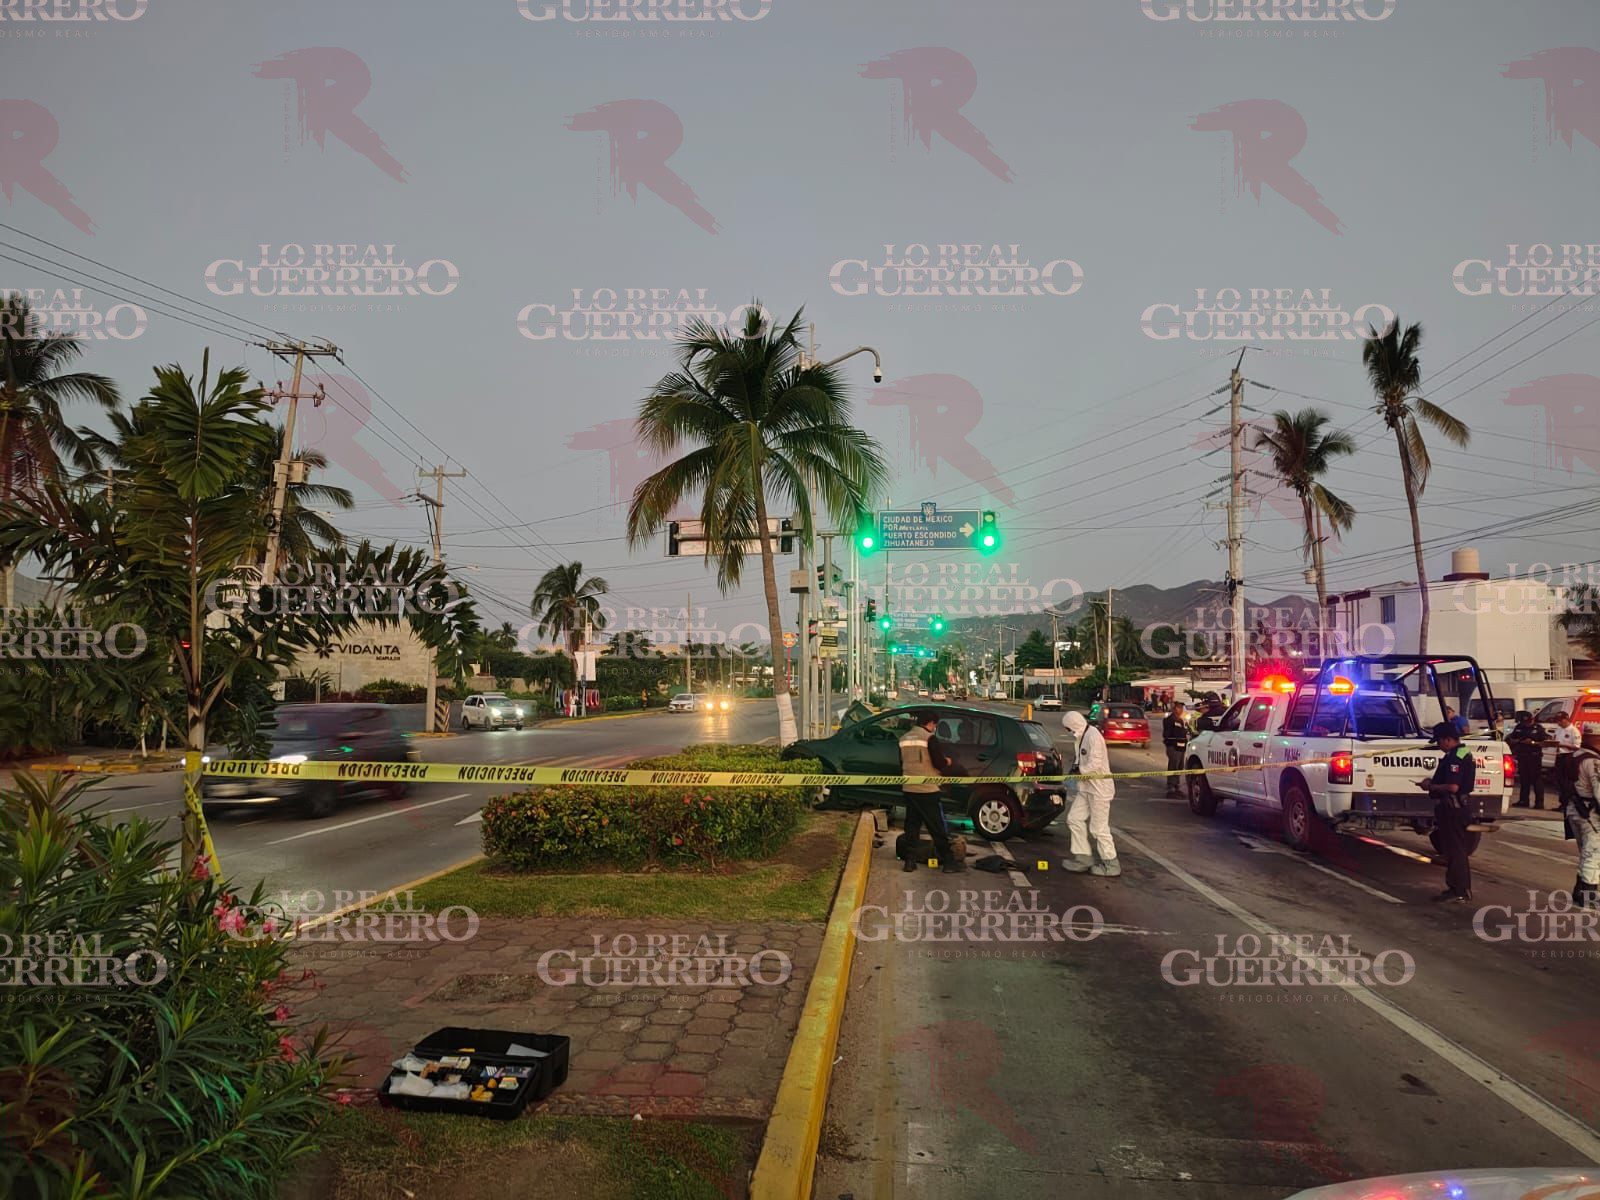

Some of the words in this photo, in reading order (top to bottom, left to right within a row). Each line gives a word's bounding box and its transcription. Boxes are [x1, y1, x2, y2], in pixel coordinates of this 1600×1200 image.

[925, 515, 953, 523] MEXICO
[883, 531, 912, 539] PUERTO
[915, 531, 957, 539] ESCONDIDO
[883, 539, 935, 547] ZIHUATANEJO
[338, 643, 401, 655] VIDANTA
[1373, 756, 1422, 768] POLICIA
[338, 763, 429, 778] PRECAUCION
[458, 766, 537, 781] PRECAUCION
[560, 769, 629, 783] PRECAUCION
[650, 772, 712, 785] PRECAUCION
[729, 774, 785, 785] PRECAUCION
